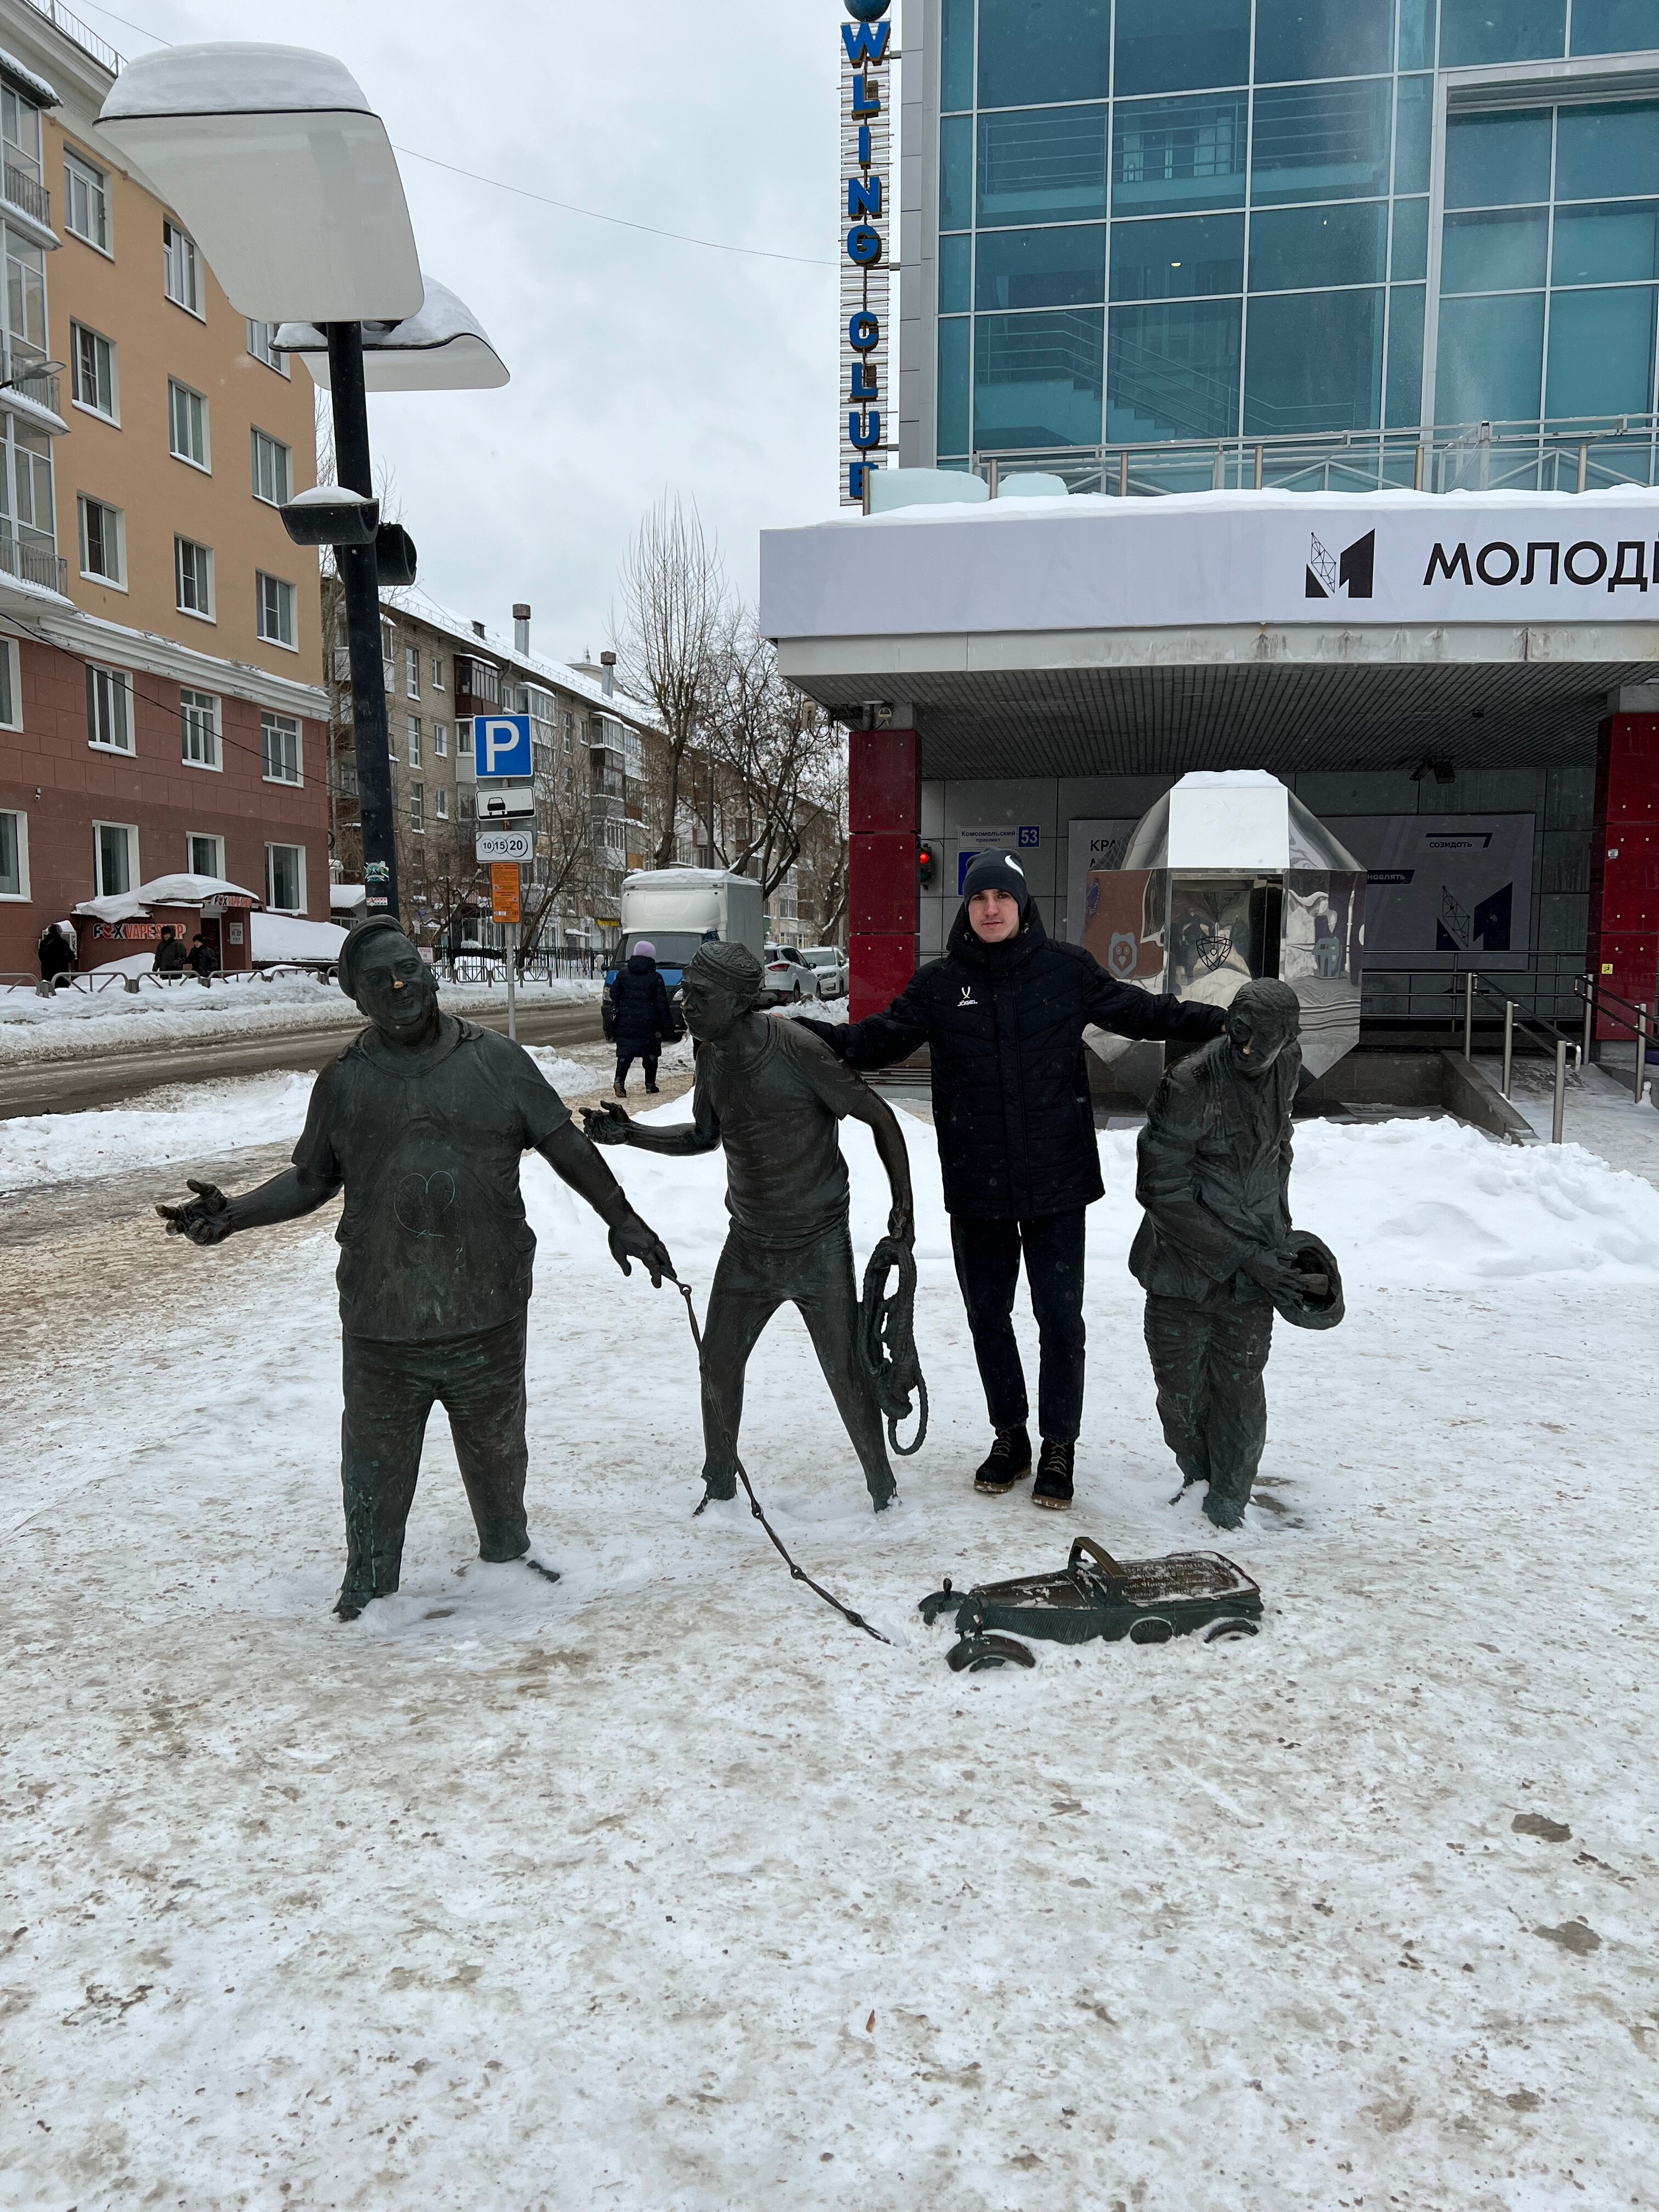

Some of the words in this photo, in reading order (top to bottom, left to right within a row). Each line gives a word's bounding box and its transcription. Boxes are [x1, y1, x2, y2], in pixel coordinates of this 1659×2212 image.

[1423, 532, 1659, 592] МОЛОД
[1021, 829, 1038, 844] 53
[495, 841, 505, 850] 15
[509, 840, 523, 850] 20
[125, 923, 154, 939] VAPE
[155, 923, 184, 939] SP
